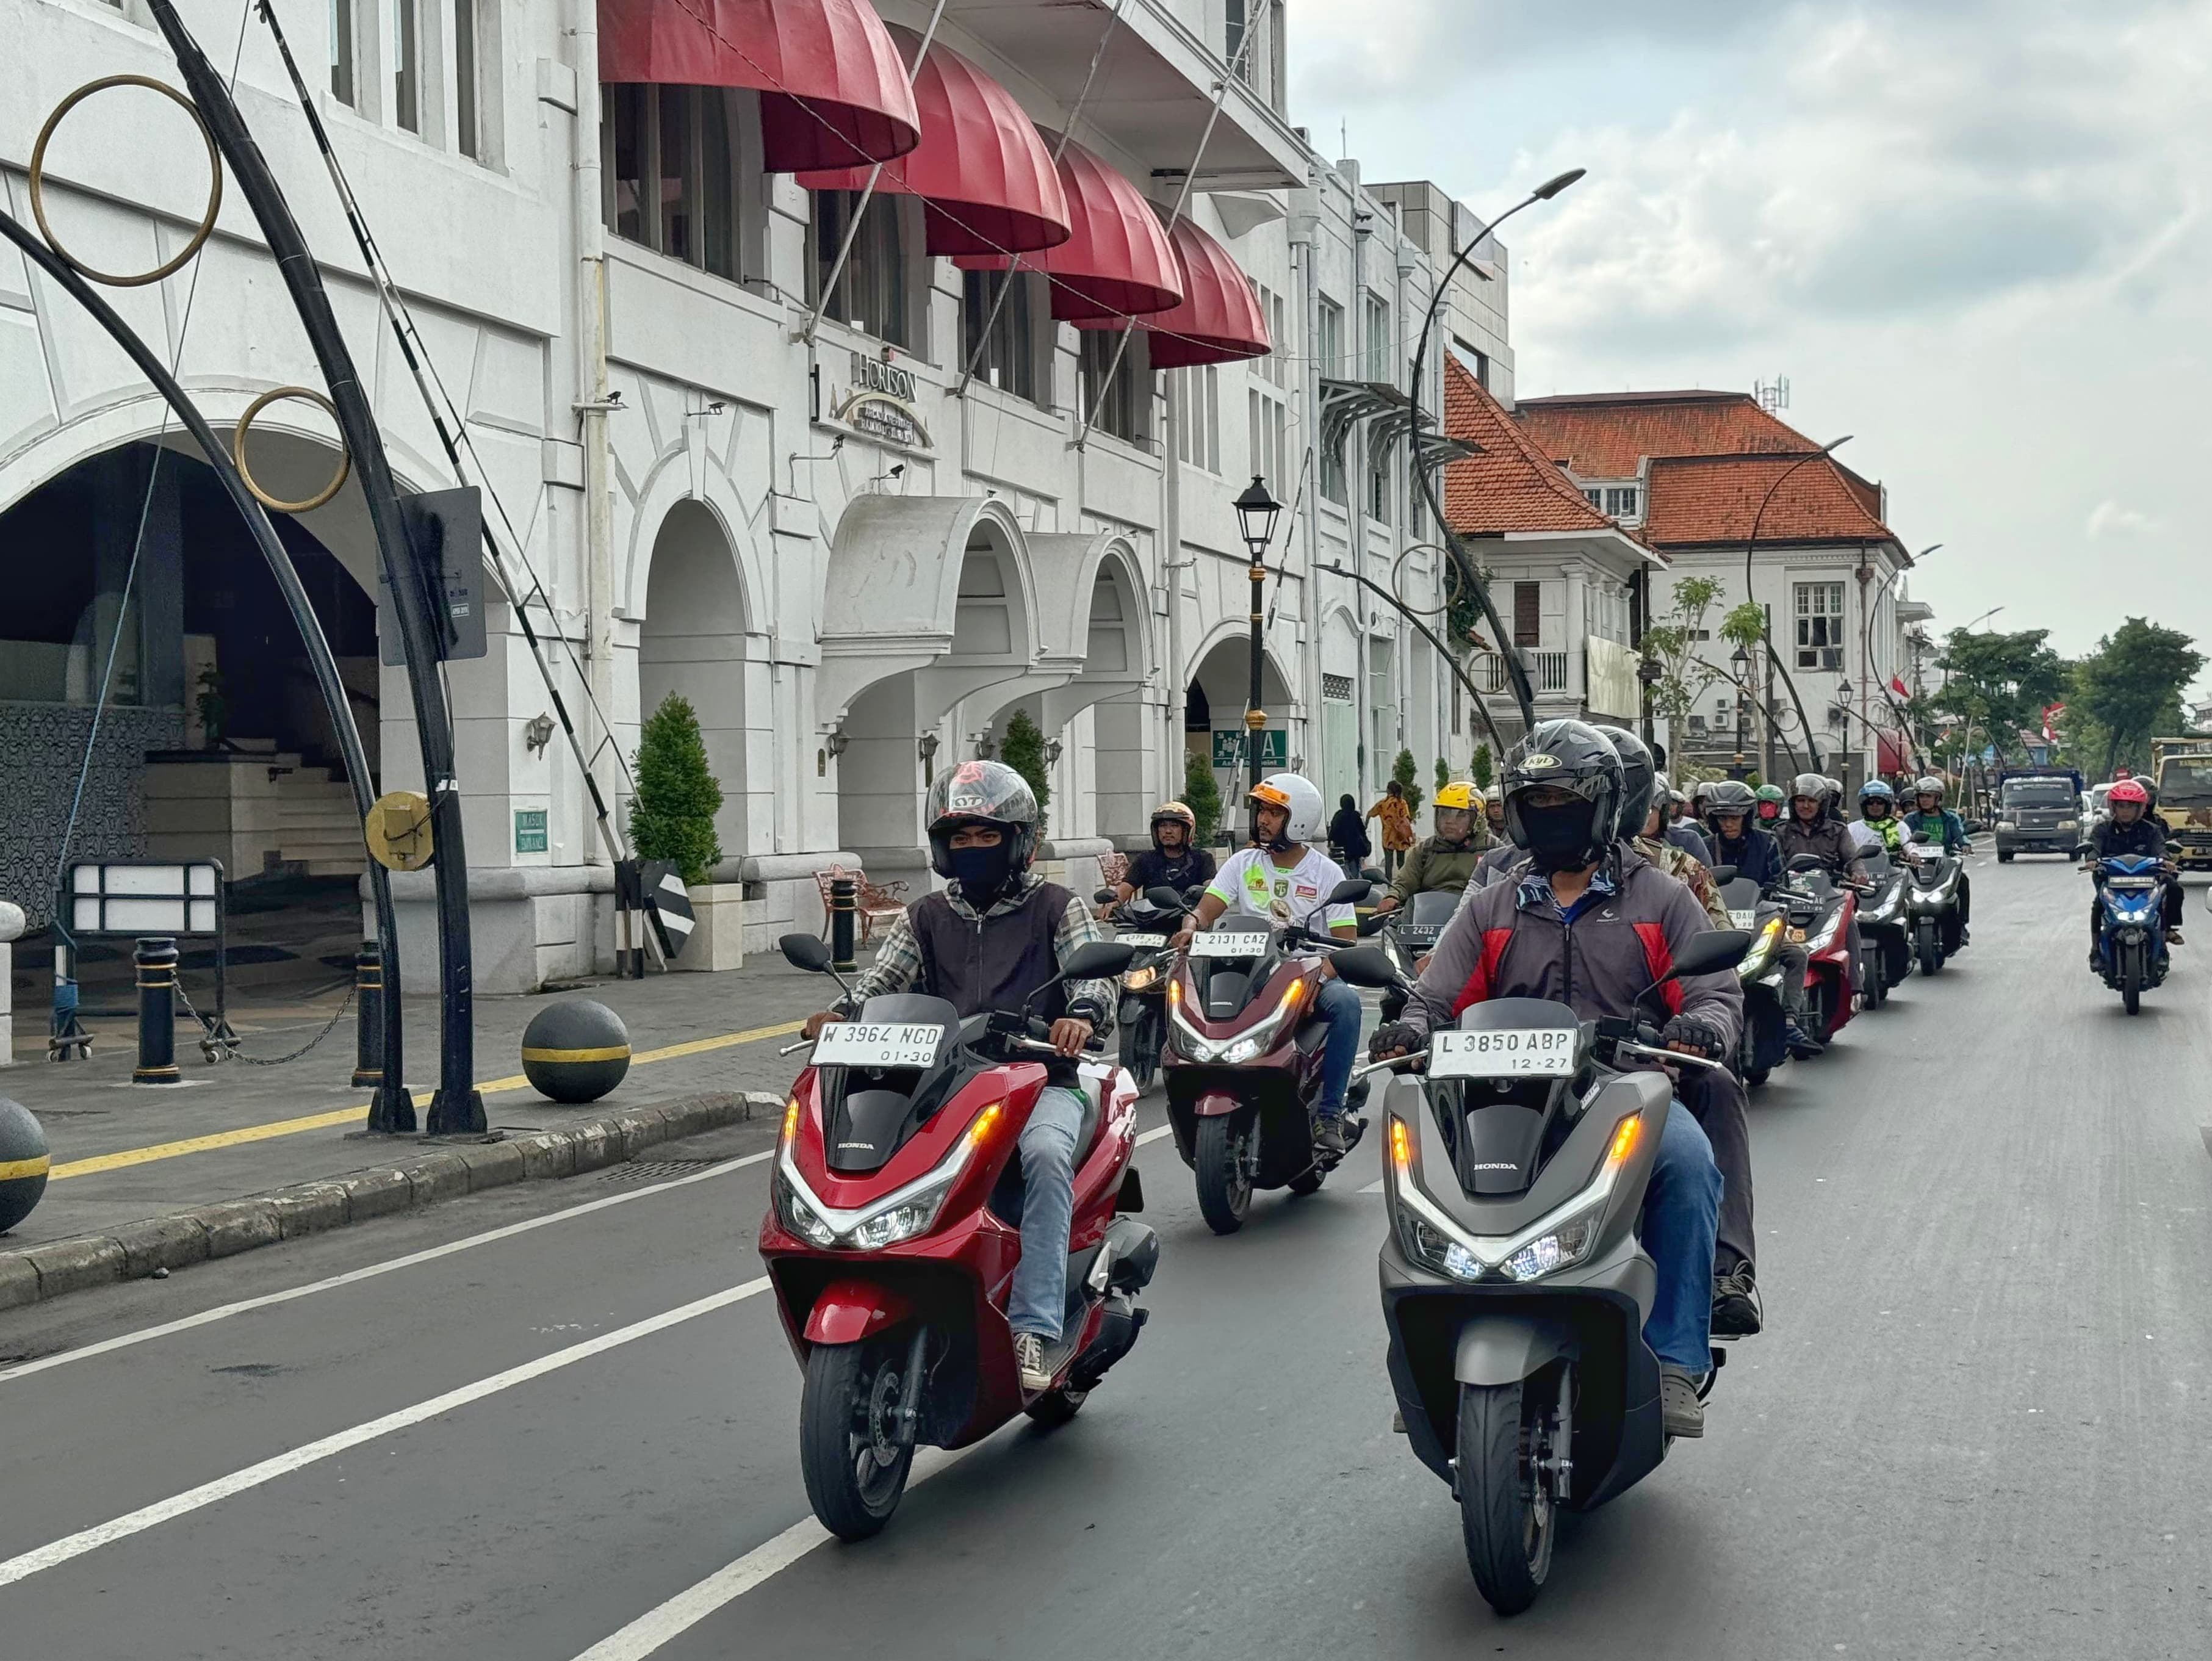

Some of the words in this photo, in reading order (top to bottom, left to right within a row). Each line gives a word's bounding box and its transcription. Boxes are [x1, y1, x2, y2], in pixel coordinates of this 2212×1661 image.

[860, 354, 917, 403] HORISON
[1195, 934, 1201, 944] L
[1244, 934, 1266, 944] CAZ
[823, 1026, 838, 1042] W
[845, 1026, 892, 1042] 3964
[899, 1028, 938, 1044] NGD
[1443, 1036, 1453, 1053] L
[1464, 1034, 1518, 1052] 3850
[1526, 1032, 1568, 1050] ABP
[1474, 1162, 1518, 1171] HONDA
